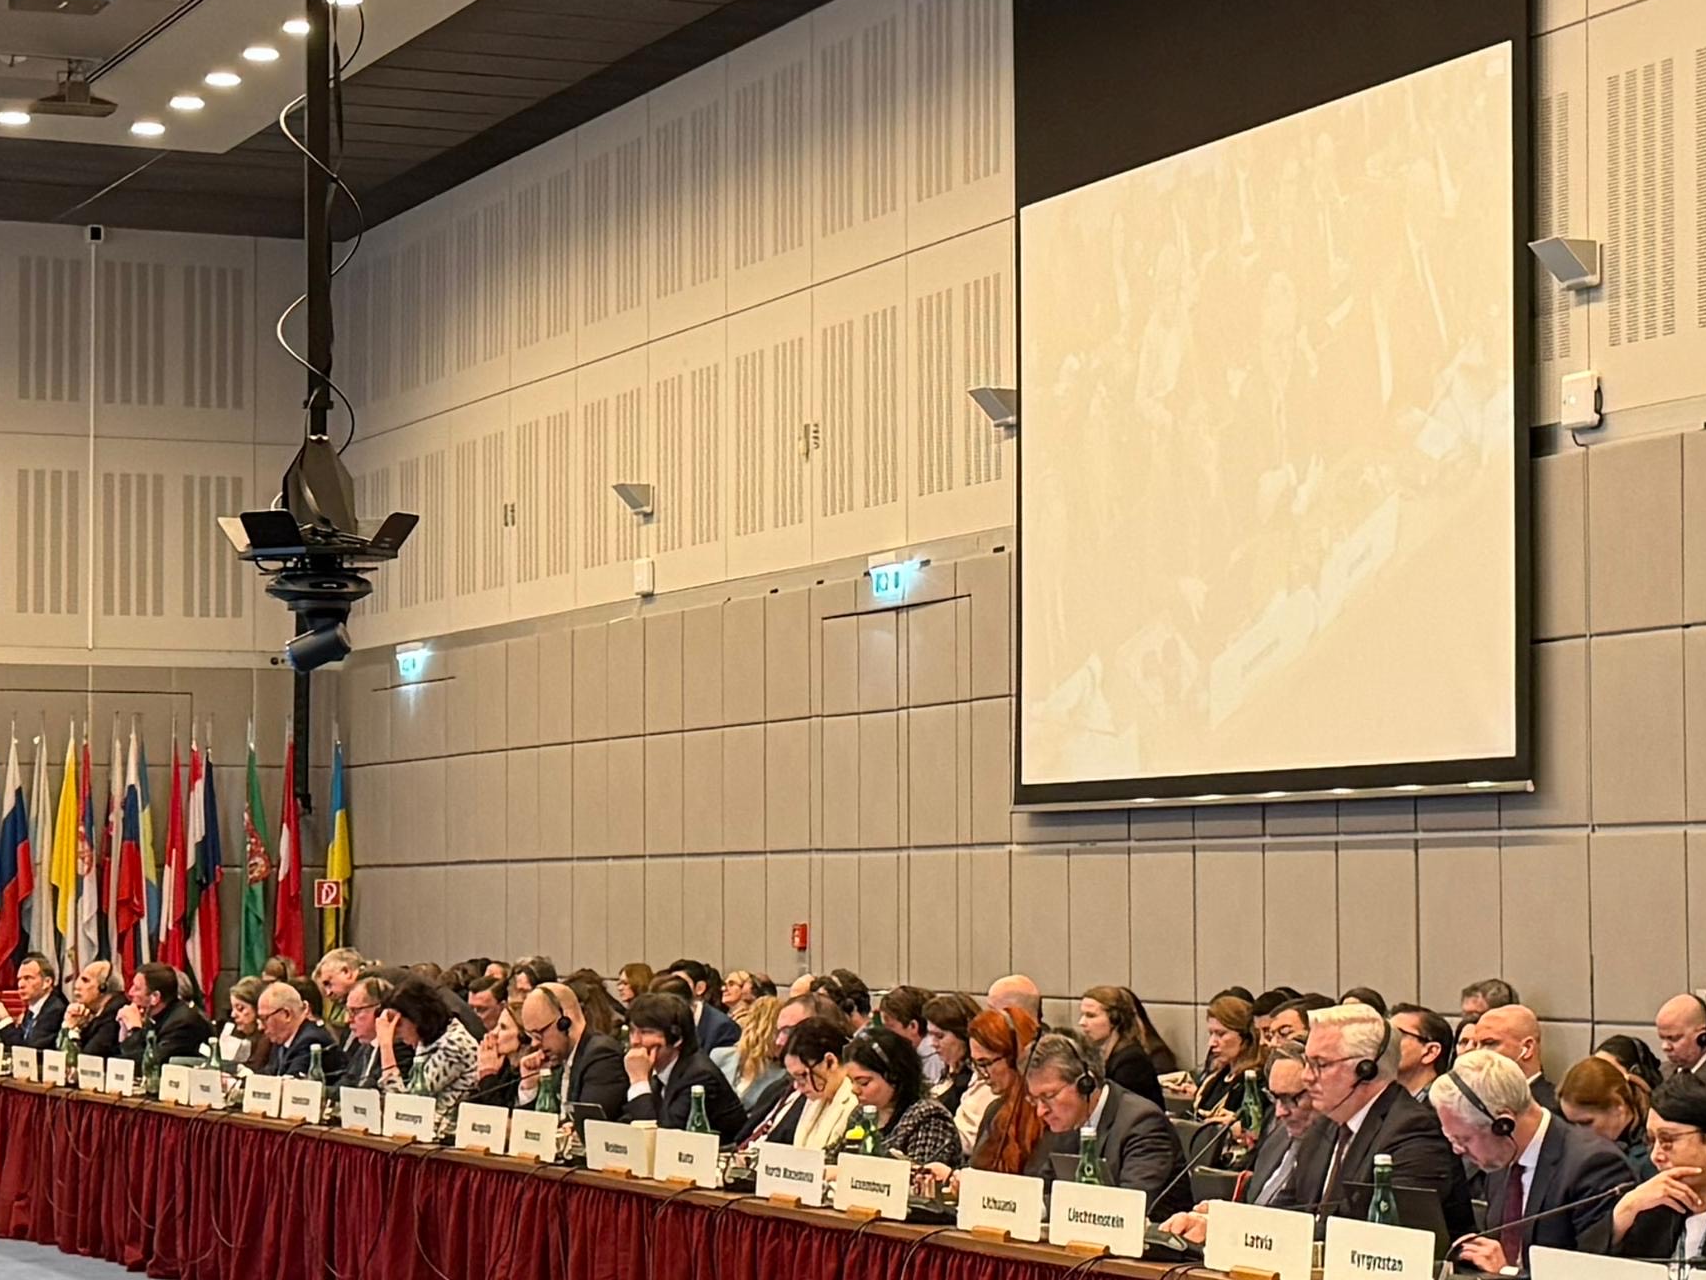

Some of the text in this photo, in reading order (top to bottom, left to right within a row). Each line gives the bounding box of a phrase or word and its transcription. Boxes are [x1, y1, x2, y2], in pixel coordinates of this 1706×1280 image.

[982, 1196, 1017, 1214] Lithuania
[1068, 1207, 1124, 1228] Liechtenstein
[1244, 1233, 1273, 1251] Latvia
[1350, 1250, 1403, 1273] Kyrgyzstan
